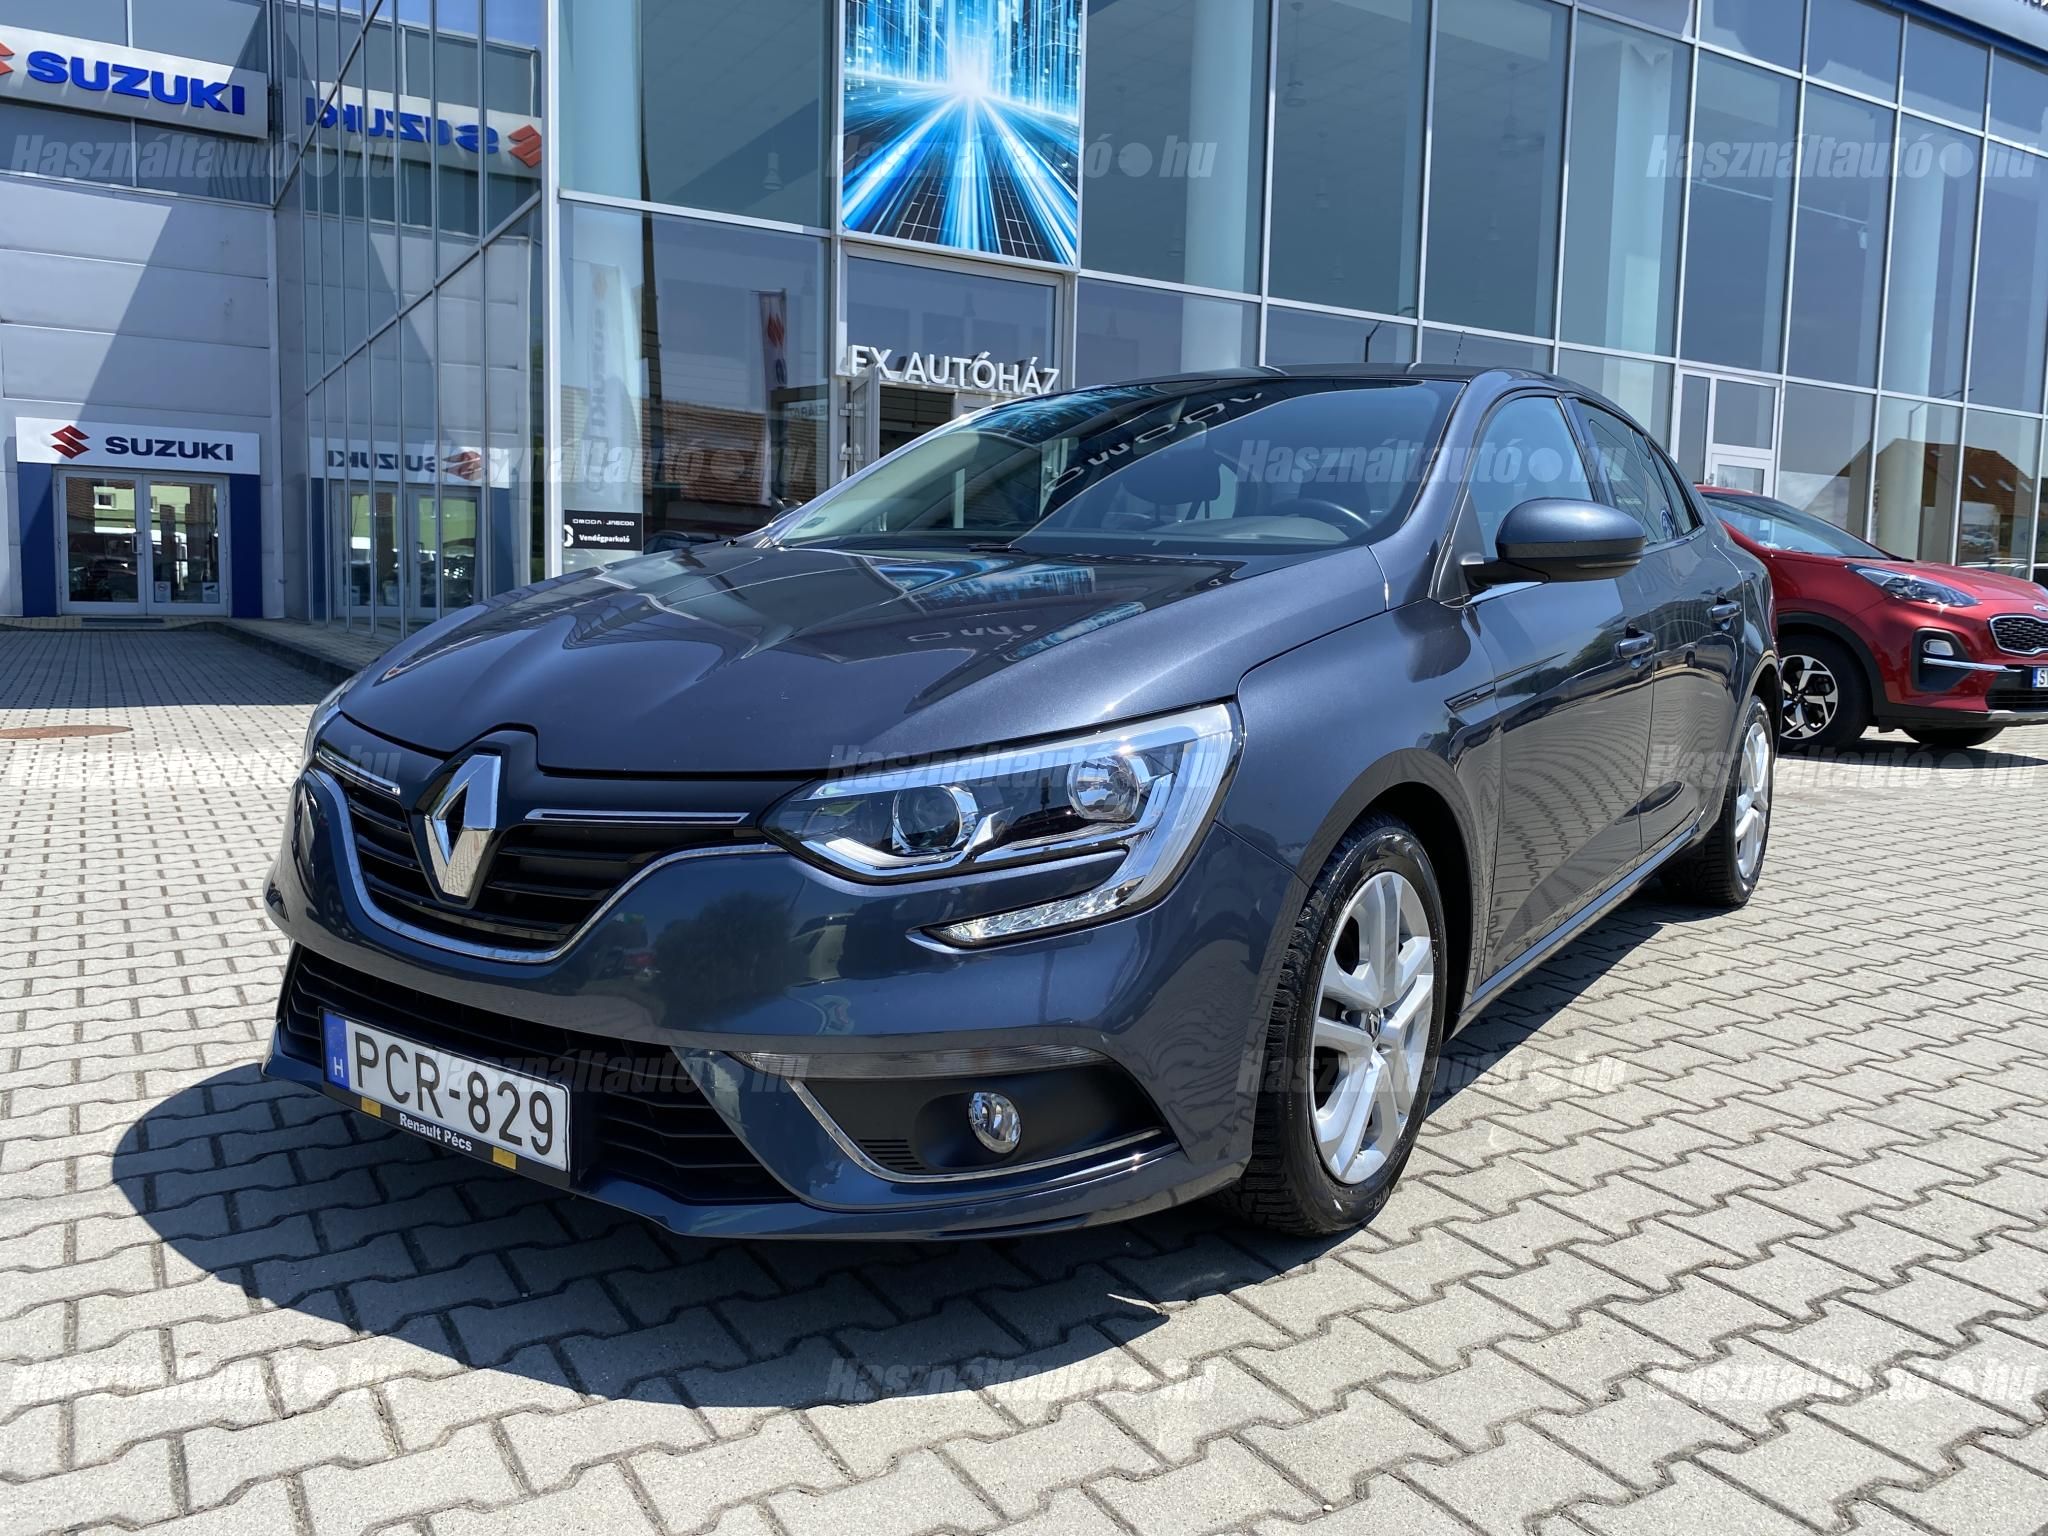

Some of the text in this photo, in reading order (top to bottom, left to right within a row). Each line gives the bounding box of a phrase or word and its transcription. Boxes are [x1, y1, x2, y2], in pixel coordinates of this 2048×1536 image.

[27, 50, 245, 116] SUZUKI
[904, 351, 1060, 394] AUTÓHÁZ
[105, 436, 233, 461] SUZUKI
[579, 533, 630, 543] Vendégparkoló
[332, 1056, 344, 1079] H
[355, 1031, 553, 1156] PCR-829
[400, 1112, 473, 1151] Renault Pécs
